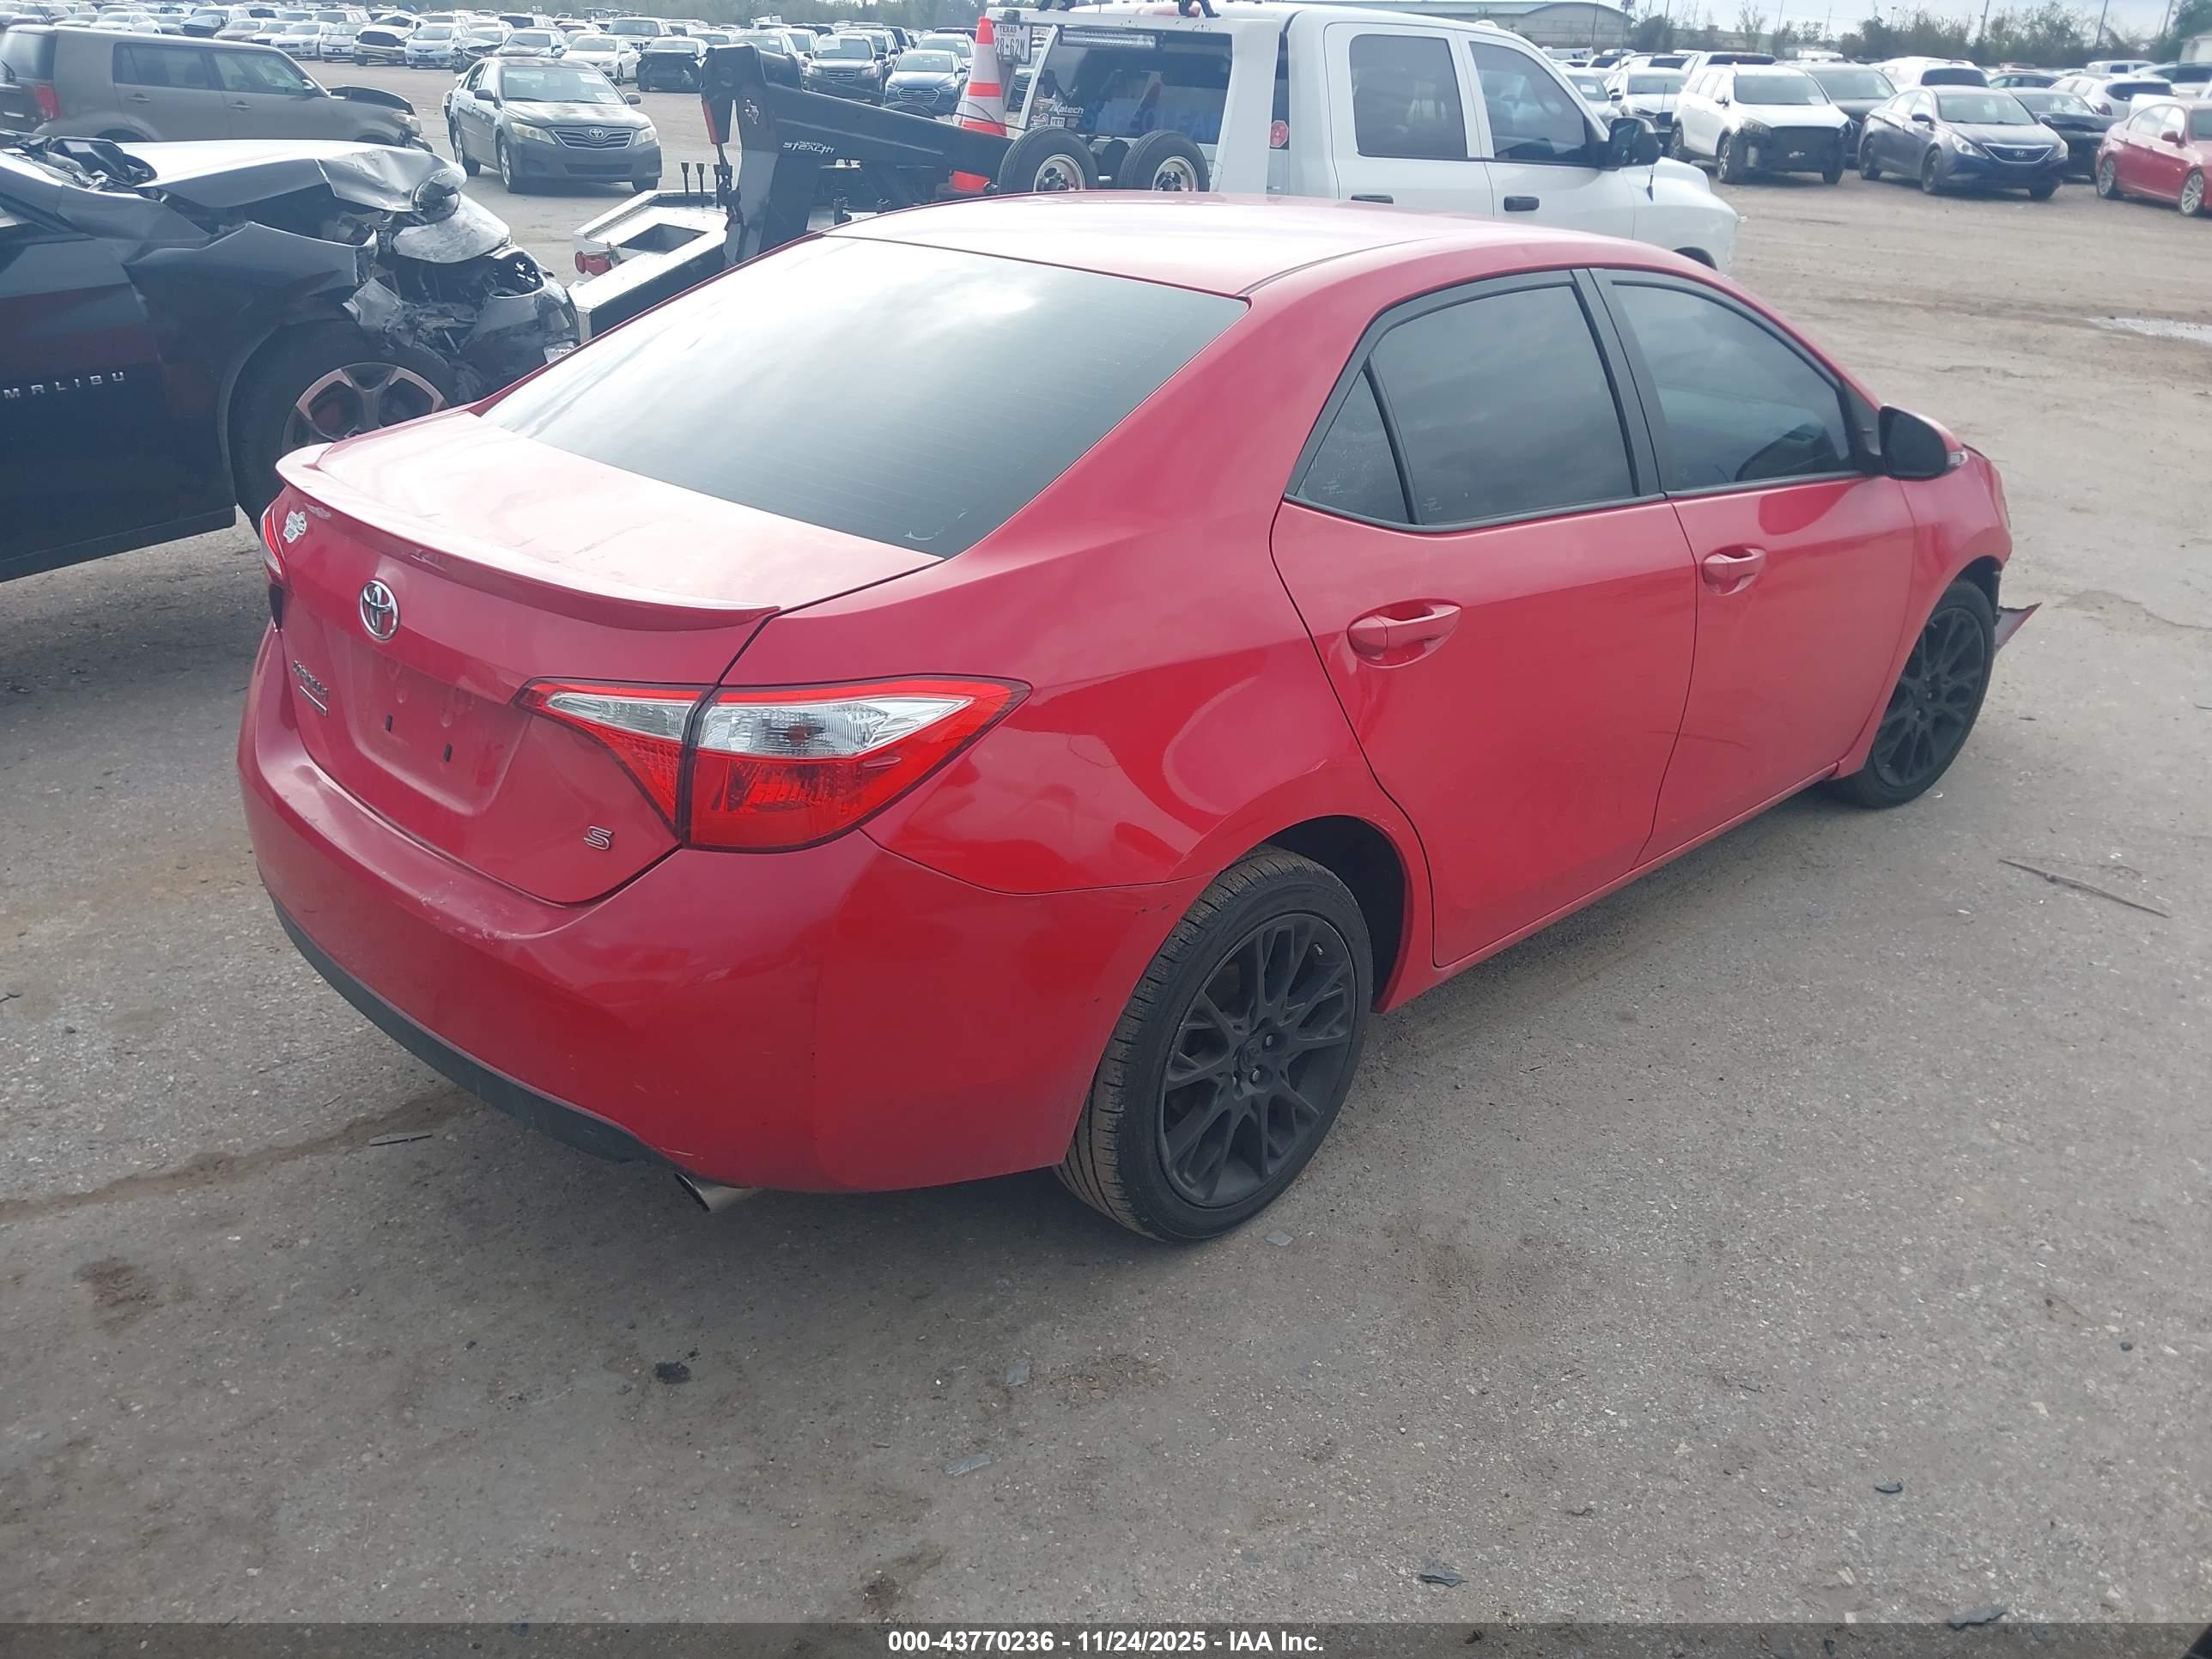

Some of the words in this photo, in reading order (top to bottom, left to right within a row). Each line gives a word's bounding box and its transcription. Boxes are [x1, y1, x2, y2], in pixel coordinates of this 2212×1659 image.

[999, 25, 1018, 33] TEXAS
[1052, 118, 1064, 126] YETI
[3, 371, 125, 399] MALIBU
[583, 825, 613, 851] S
